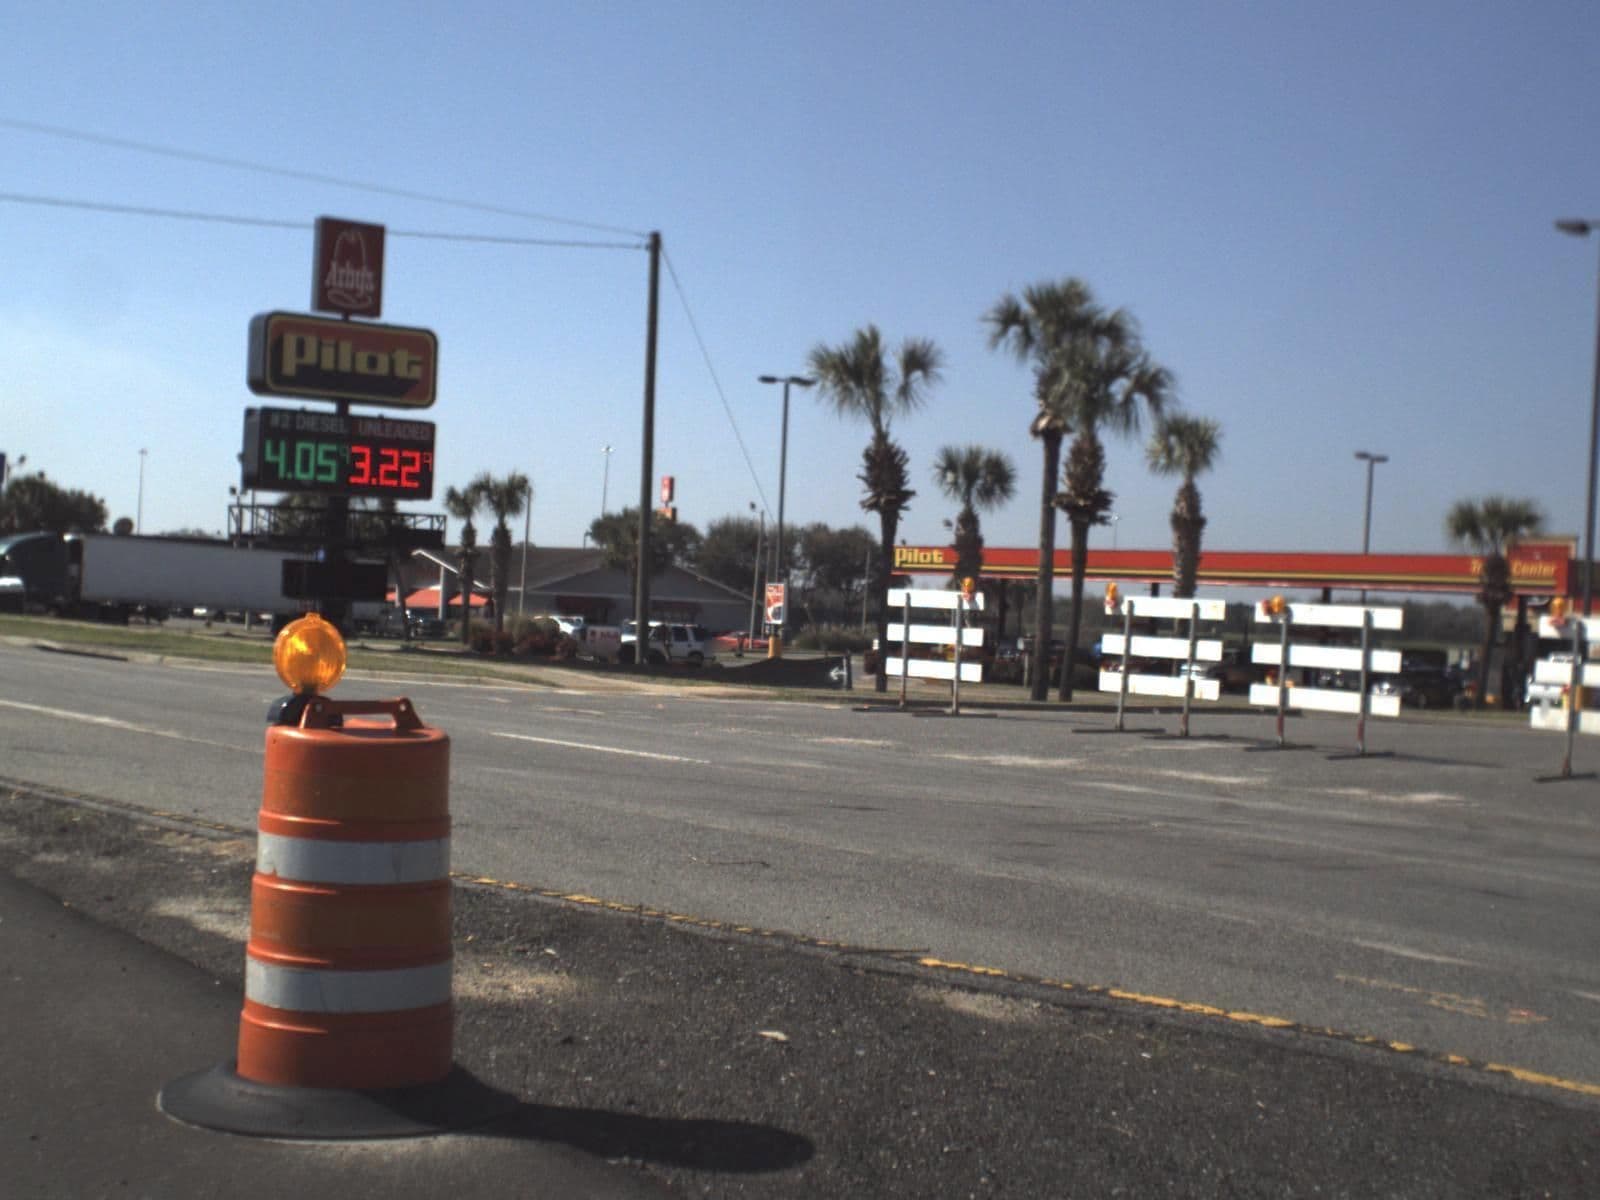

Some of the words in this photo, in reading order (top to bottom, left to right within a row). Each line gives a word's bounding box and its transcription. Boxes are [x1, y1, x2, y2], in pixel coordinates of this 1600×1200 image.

[281, 333, 423, 380] Pilot
[296, 415, 347, 434] DIESEL
[358, 420, 431, 441] UNLEADED
[895, 547, 944, 568] Pilot
